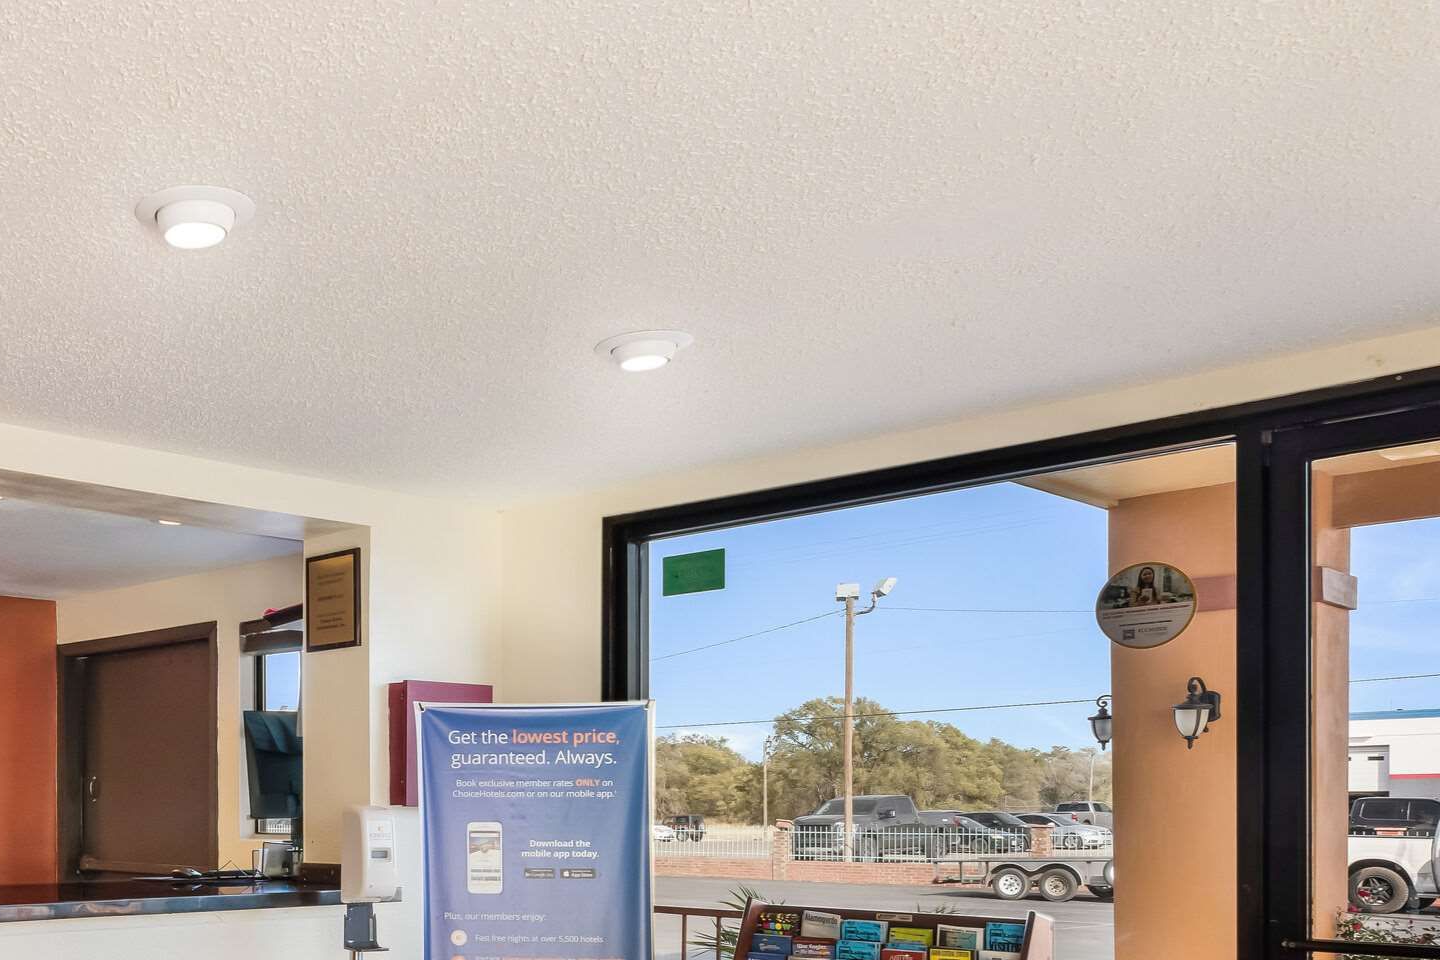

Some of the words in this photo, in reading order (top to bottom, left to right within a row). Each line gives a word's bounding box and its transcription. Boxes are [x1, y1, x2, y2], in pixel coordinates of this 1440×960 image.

[448, 730, 477, 744] Get
[481, 729, 508, 744] the
[512, 729, 568, 744] lowest
[573, 729, 620, 747] price,
[451, 750, 550, 769] guaranteed.
[555, 750, 617, 769] Always.
[456, 779, 477, 787] Book
[478, 779, 514, 787] exclusive
[516, 779, 551, 787] member
[576, 779, 600, 787] ONLY
[529, 839, 573, 847] Download
[575, 839, 591, 847] the
[553, 851, 570, 859] app
[572, 850, 600, 859] today.
[481, 912, 520, 920] members
